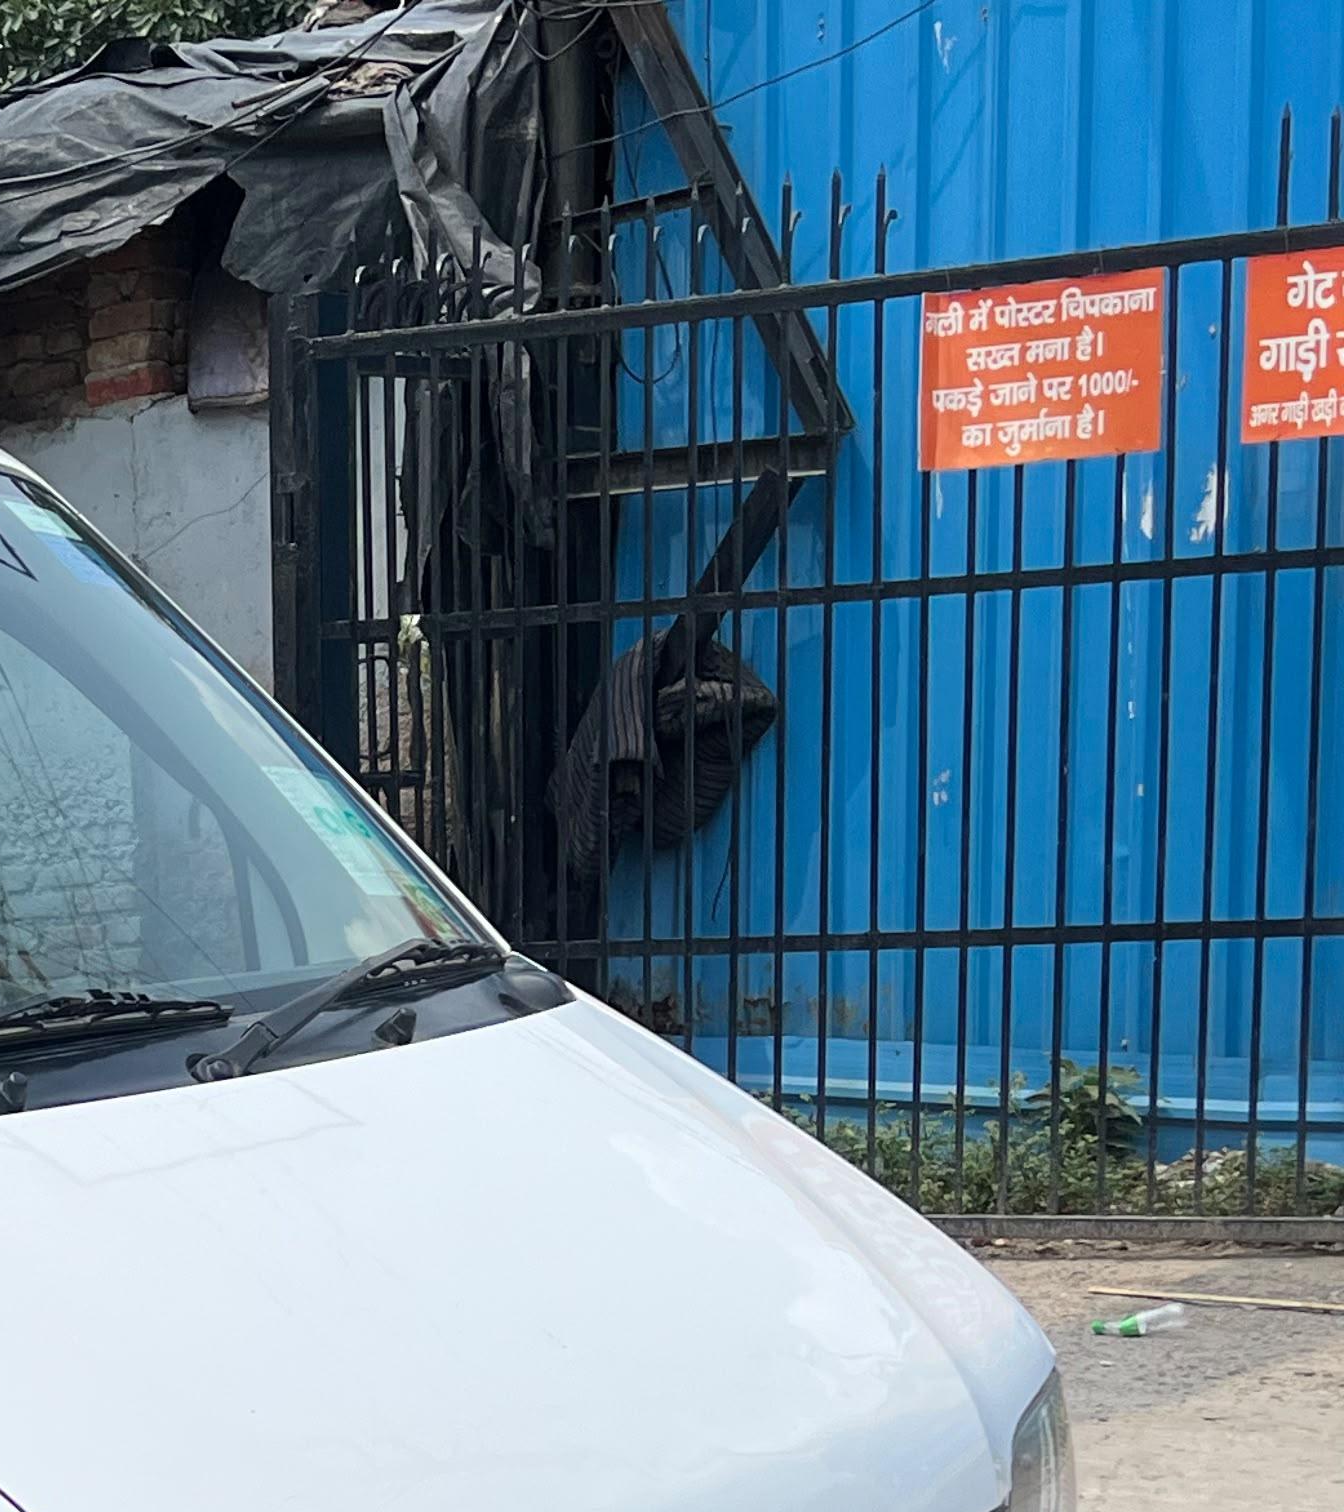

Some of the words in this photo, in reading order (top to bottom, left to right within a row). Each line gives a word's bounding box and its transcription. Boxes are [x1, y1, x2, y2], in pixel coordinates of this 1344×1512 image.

[969, 298, 993, 331] में
[994, 296, 1057, 328] पोस्टर
[1060, 286, 1156, 319] चिपकाना
[1287, 260, 1337, 309] गेट
[966, 343, 1020, 372] सख्त
[1025, 337, 1072, 363] मना
[1259, 318, 1330, 383] गाड़ी
[932, 377, 985, 418] पकड़े
[988, 372, 1038, 406] जाने
[1042, 376, 1074, 401] पर
[1078, 369, 1139, 397] 1000/-
[961, 423, 993, 448] का
[996, 409, 1072, 457] जुर्माना
